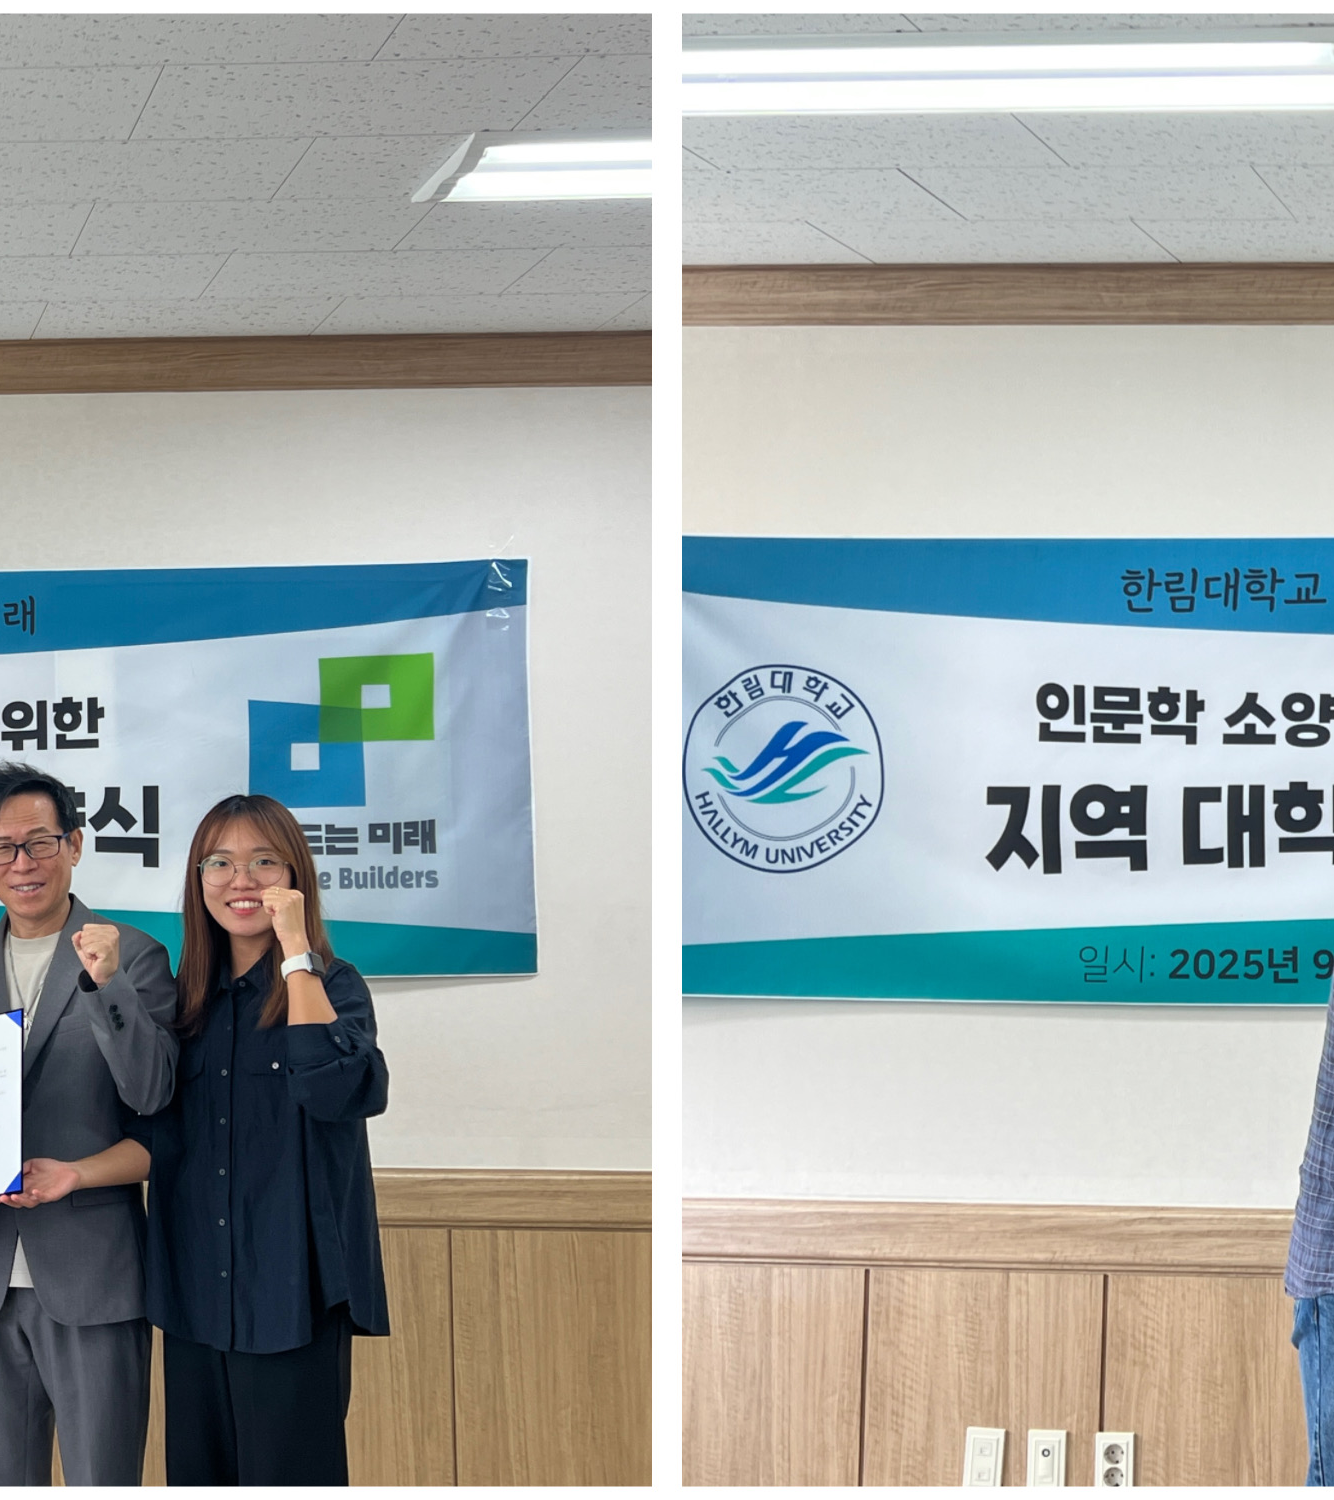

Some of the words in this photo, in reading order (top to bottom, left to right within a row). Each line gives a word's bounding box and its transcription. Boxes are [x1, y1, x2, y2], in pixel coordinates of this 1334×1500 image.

[1121, 567, 1327, 613] 한림대학교
[714, 670, 855, 720] 한림대학교
[1036, 682, 1205, 745] 인문학
[1, 697, 105, 751] 위한
[368, 819, 437, 854] 미래
[695, 791, 759, 860] HALLYM
[765, 794, 873, 864] UNIVERSITY
[985, 783, 1148, 875] 지역
[339, 865, 439, 890] Builders
[1079, 945, 1156, 983] 일시:
[1168, 946, 1299, 984] 2025년
